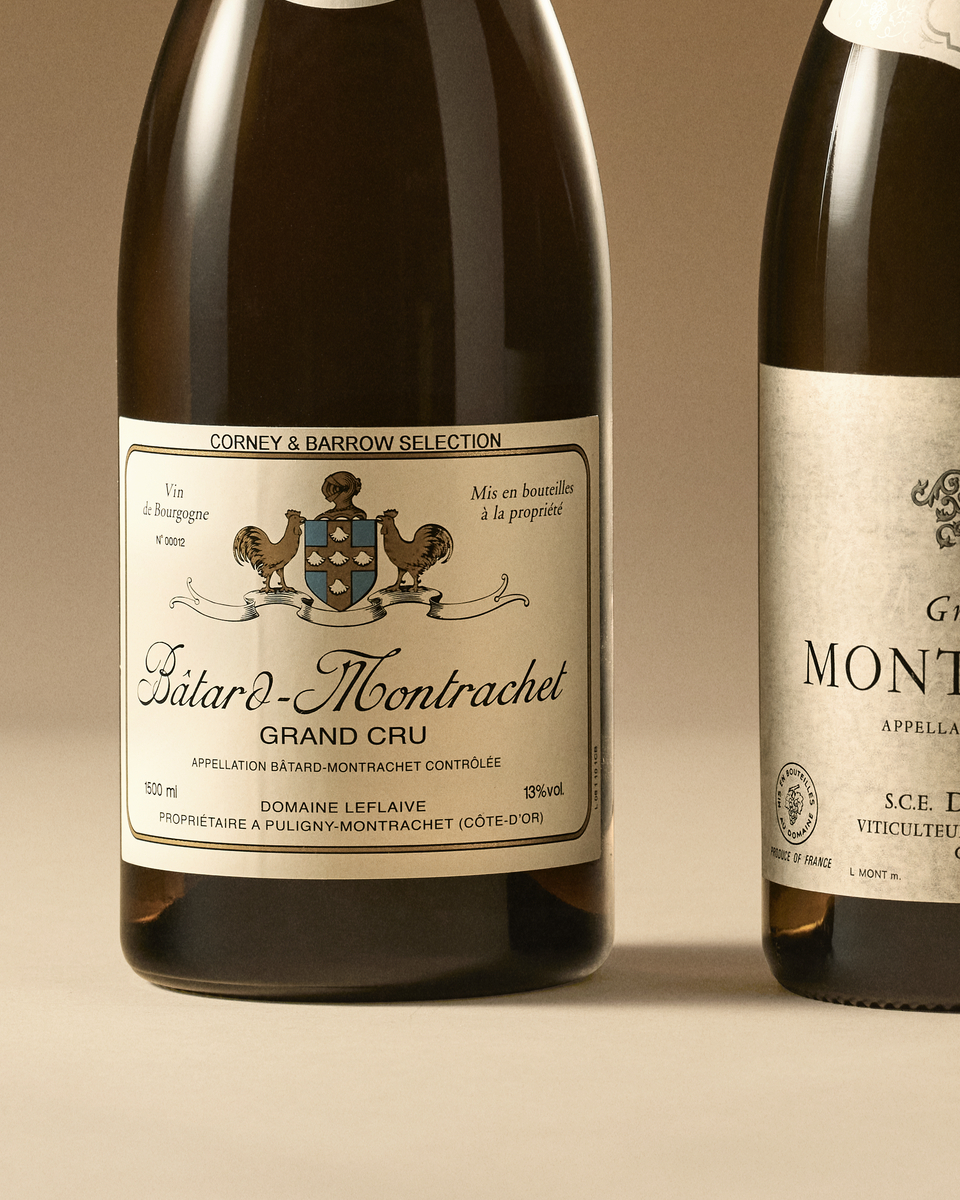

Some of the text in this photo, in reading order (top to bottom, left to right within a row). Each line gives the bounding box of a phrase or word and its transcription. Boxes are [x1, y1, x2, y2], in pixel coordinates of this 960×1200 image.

[210, 433, 501, 451] CORNEY & BARROW SELECTION
[165, 483, 184, 498] Vin
[471, 480, 574, 500] Mis en bouteilles
[143, 501, 210, 524] de Bourgogne
[481, 501, 563, 524] à la propriété
[165, 536, 185, 547] 00012
[259, 725, 427, 746] GRAND CRU
[191, 756, 501, 773] APPELLATION BÂTARD-MONTRACHET CONTRÔLÉE
[144, 781, 178, 798] 1500 ml
[780, 774, 786, 787] EN
[786, 768, 815, 806] BOUTEILLES
[261, 801, 427, 813] DOMAINE LEFLAIVE
[885, 793, 933, 811] S.C.E.
[159, 811, 544, 832] PROPRIÉTAIRE A PULIGNY-MONTRACHET (CÔTE-D'OR)
[780, 812, 814, 839] AU DOMAINE
[770, 846, 832, 869] PRODUCE OF FRANCE
[849, 867, 855, 876] L
[859, 868, 888, 879] MONT
